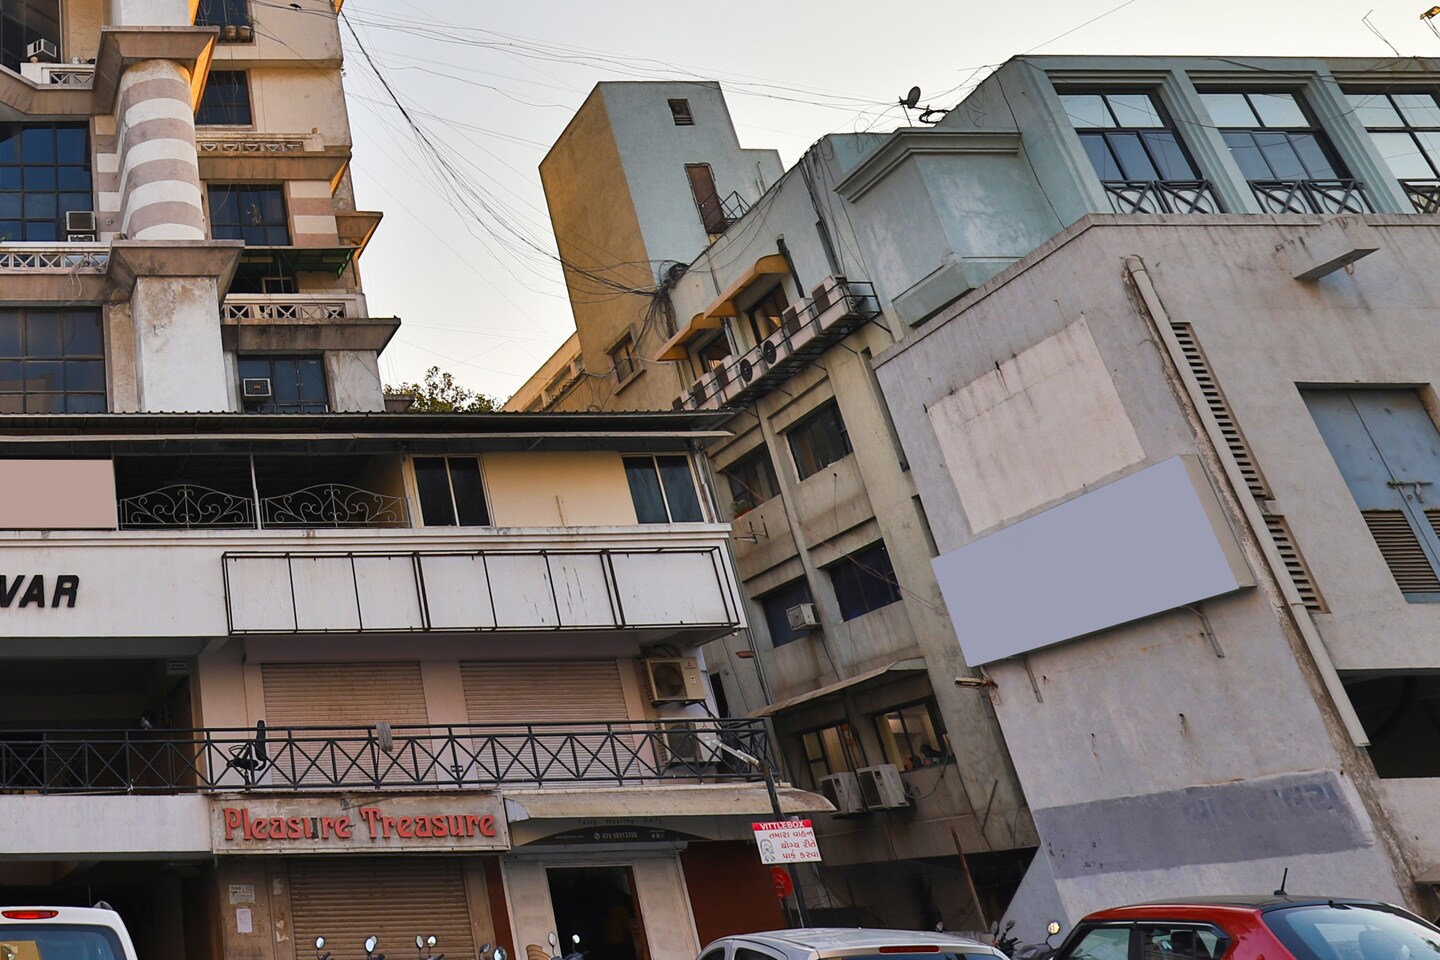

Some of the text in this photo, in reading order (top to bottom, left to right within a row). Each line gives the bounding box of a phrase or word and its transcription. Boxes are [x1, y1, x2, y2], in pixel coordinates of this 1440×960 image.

[223, 807, 496, 840] Pleasure Treasure
[759, 820, 805, 831] VITTLEBOX
[793, 830, 813, 838] વાહન
